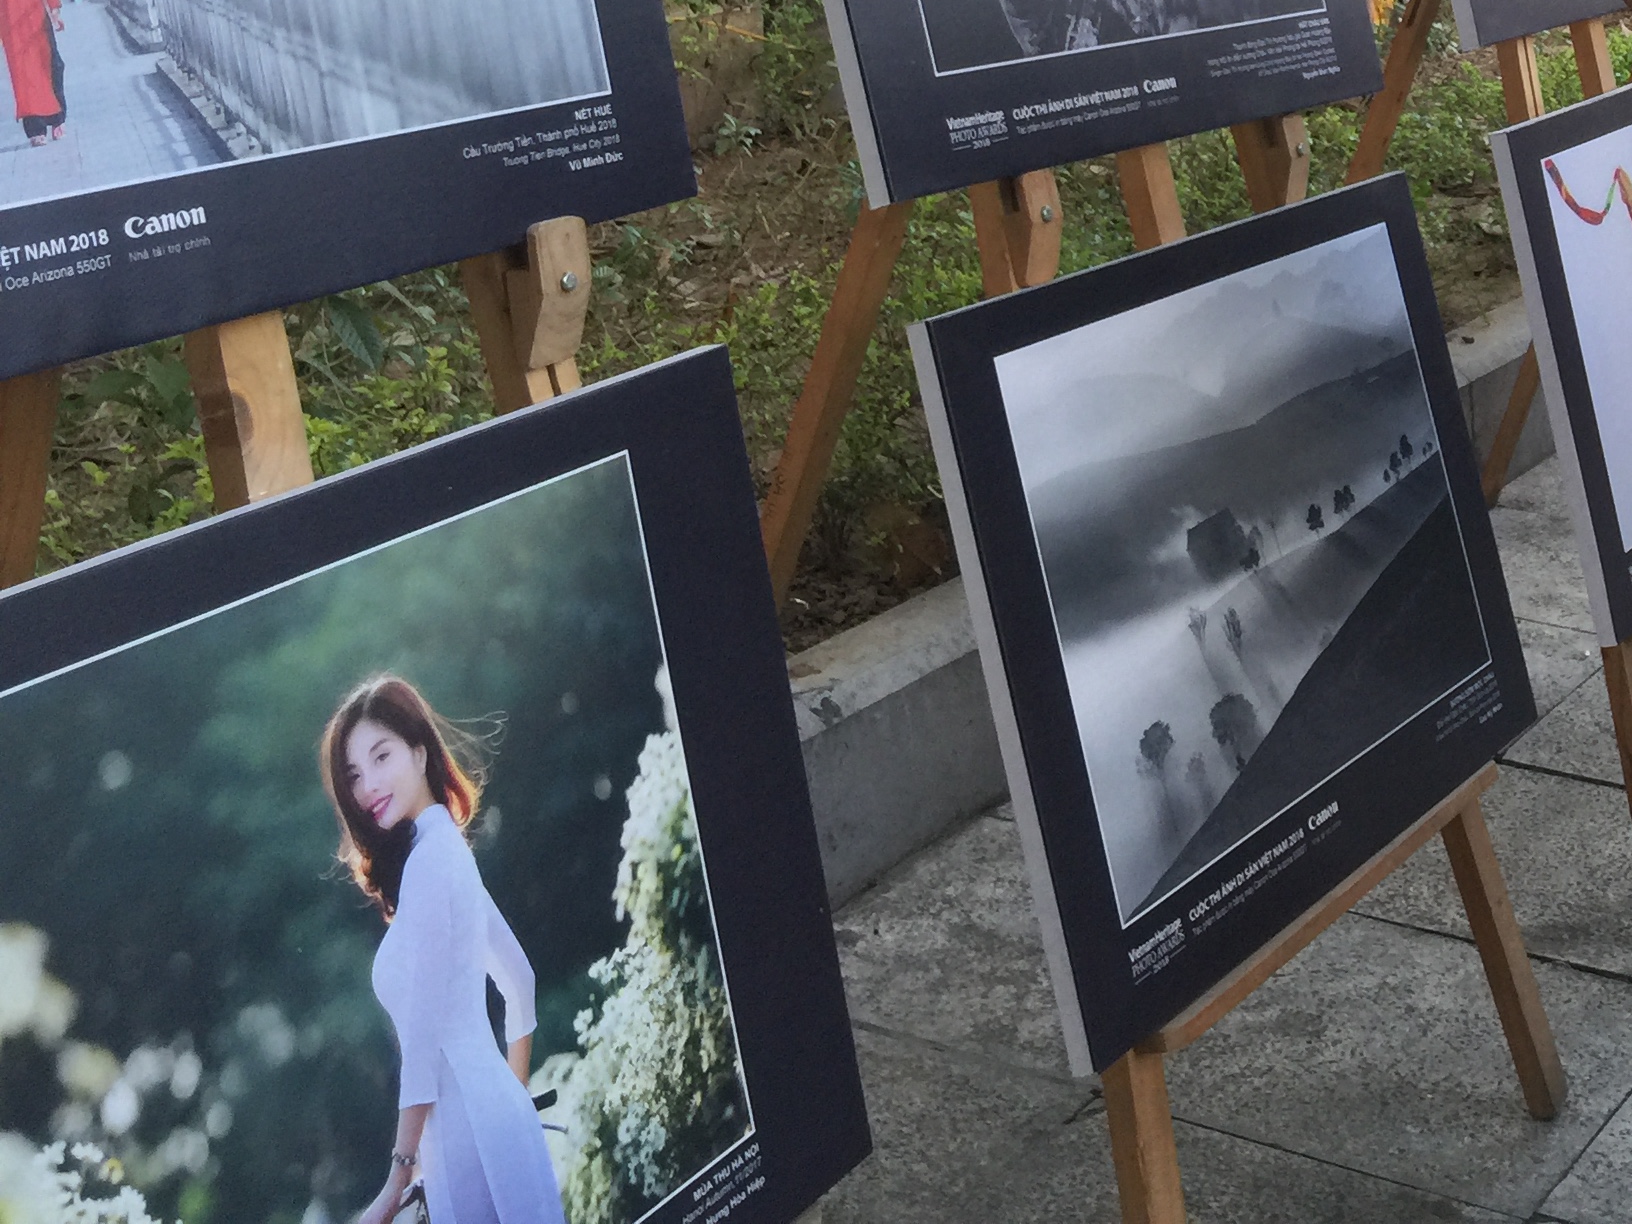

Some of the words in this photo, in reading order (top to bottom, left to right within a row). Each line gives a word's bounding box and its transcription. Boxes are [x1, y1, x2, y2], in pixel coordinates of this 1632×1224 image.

[1143, 76, 1178, 94] Canon
[597, 117, 618, 132] 2018
[949, 128, 977, 144] PHOTO
[582, 154, 605, 169] Minh
[124, 206, 207, 239] Canon
[0, 245, 21, 271] ỆT
[24, 237, 67, 262] NAM
[68, 228, 110, 252] 2018
[184, 234, 211, 251] chính
[4, 275, 30, 291] Oce
[31, 265, 75, 285] Arizona
[76, 254, 112, 275] 550GT
[1308, 801, 1339, 830] Canon
[693, 1179, 714, 1202] MÙA
[713, 1165, 731, 1185] THU
[730, 1154, 745, 1171] HÀ
[744, 1142, 760, 1161] NỘI
